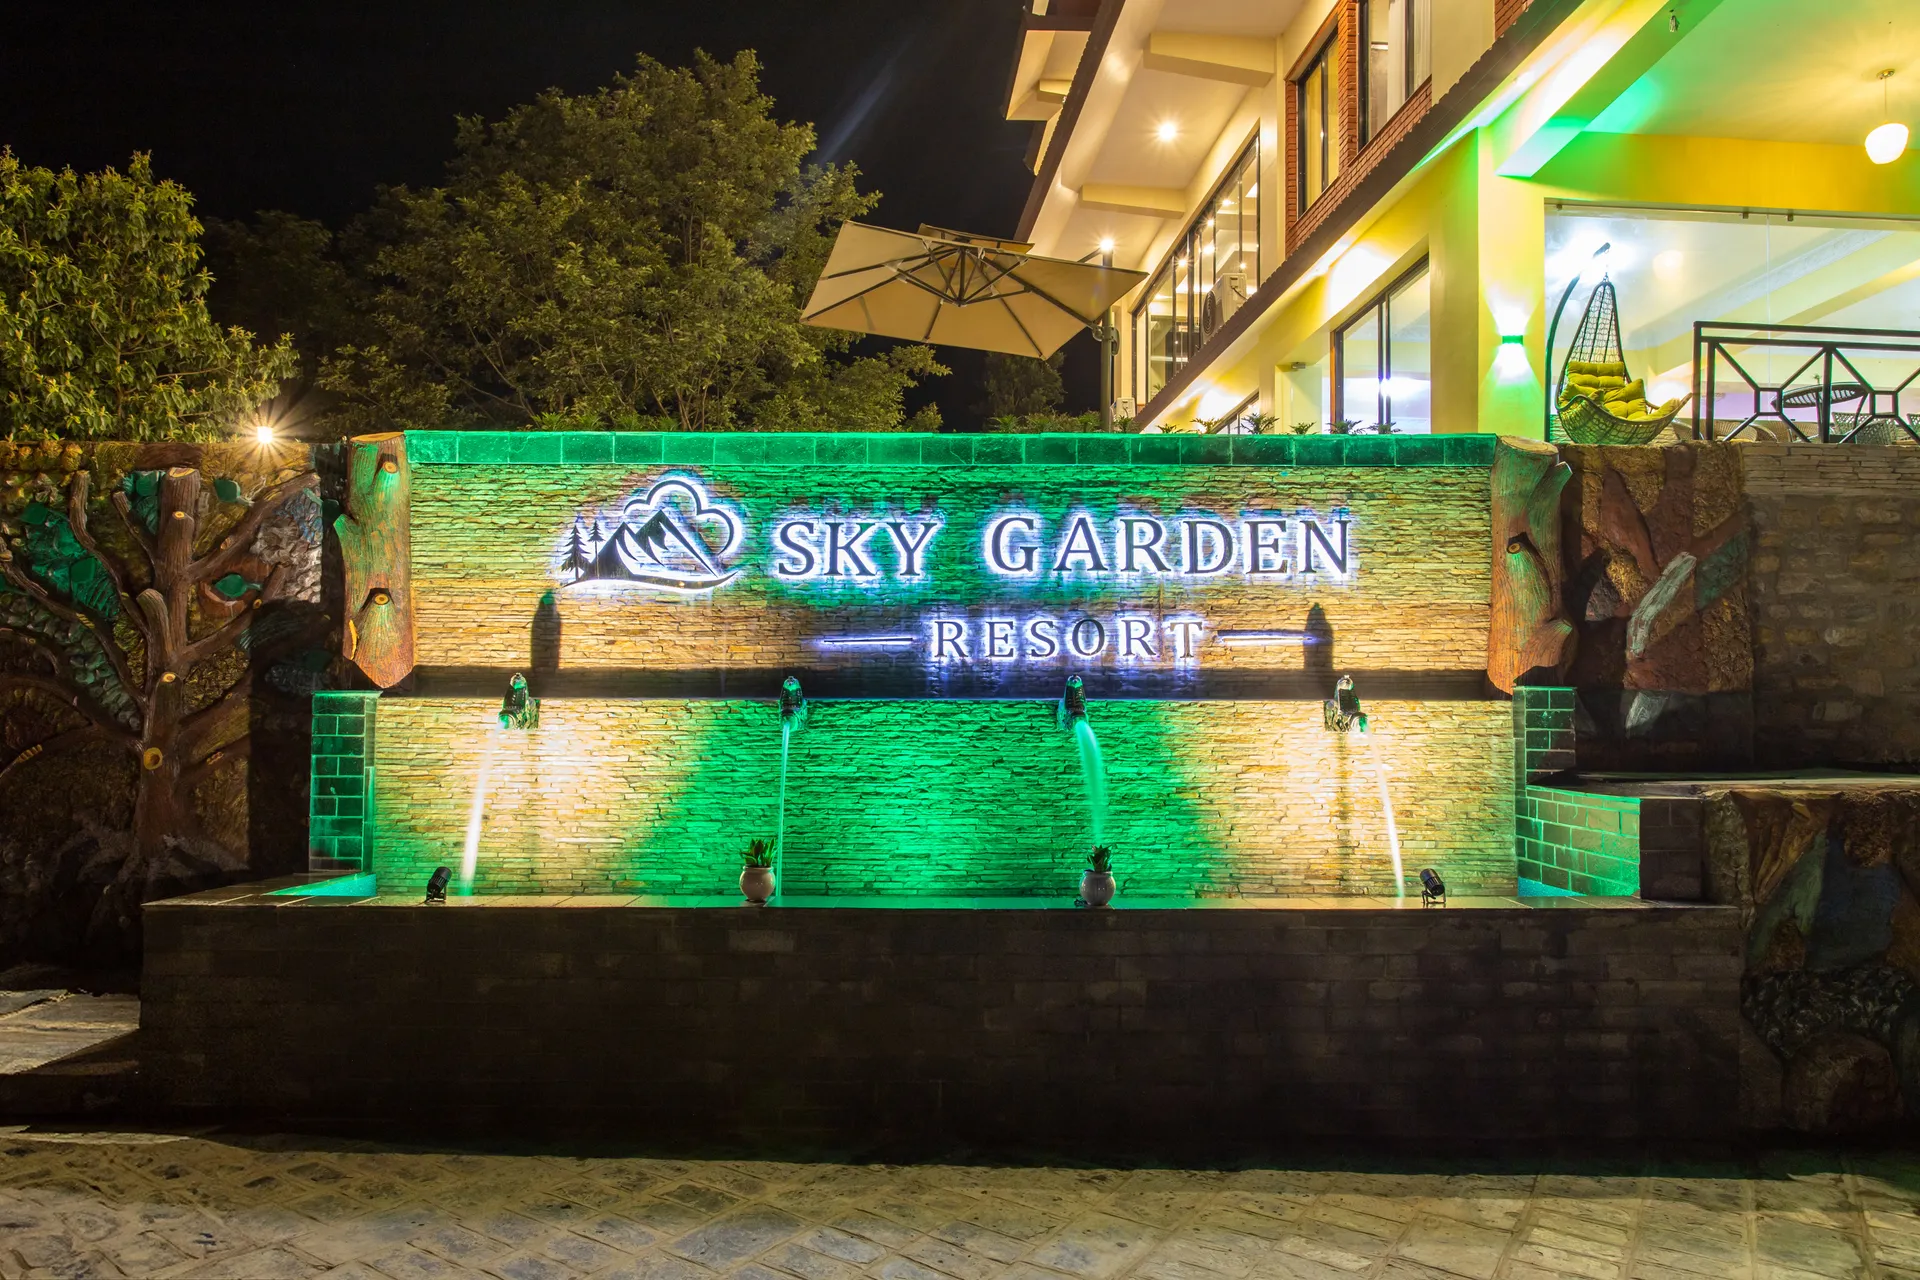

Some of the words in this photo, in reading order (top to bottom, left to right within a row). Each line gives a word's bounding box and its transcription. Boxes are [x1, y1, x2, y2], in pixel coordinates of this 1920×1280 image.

[777, 519, 939, 578] SKY
[989, 515, 1353, 576] GARDEN
[932, 617, 1204, 660] RESORT
